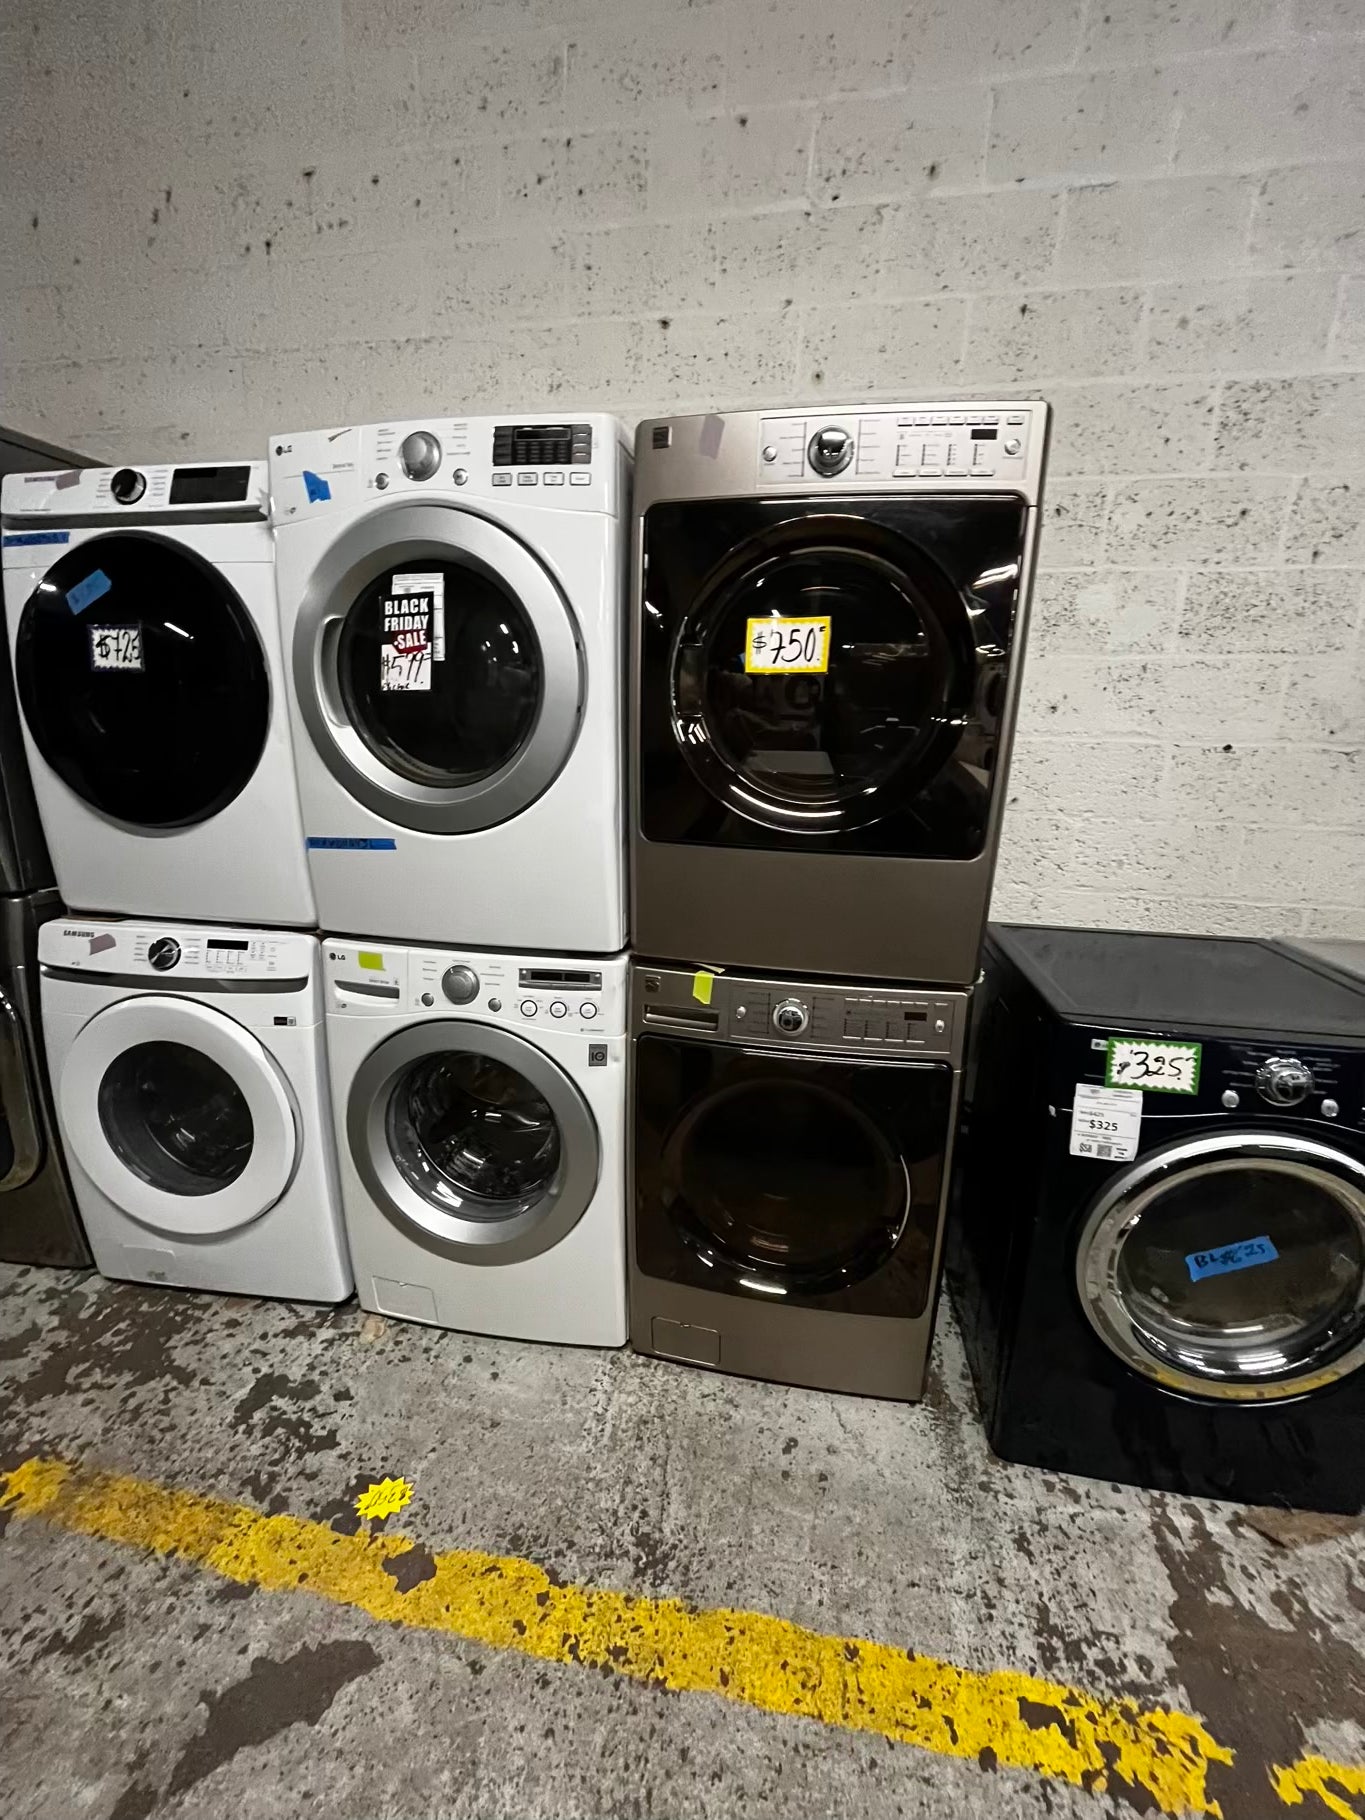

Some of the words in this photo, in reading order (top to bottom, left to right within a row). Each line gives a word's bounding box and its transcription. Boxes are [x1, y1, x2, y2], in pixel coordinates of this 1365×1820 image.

[384, 597, 429, 615] BLACK
[384, 615, 429, 631] FRIDAY
[397, 630, 427, 649] SALE
[63, 929, 95, 938] SAMSUNG
[1088, 1119, 1118, 1132] $325
